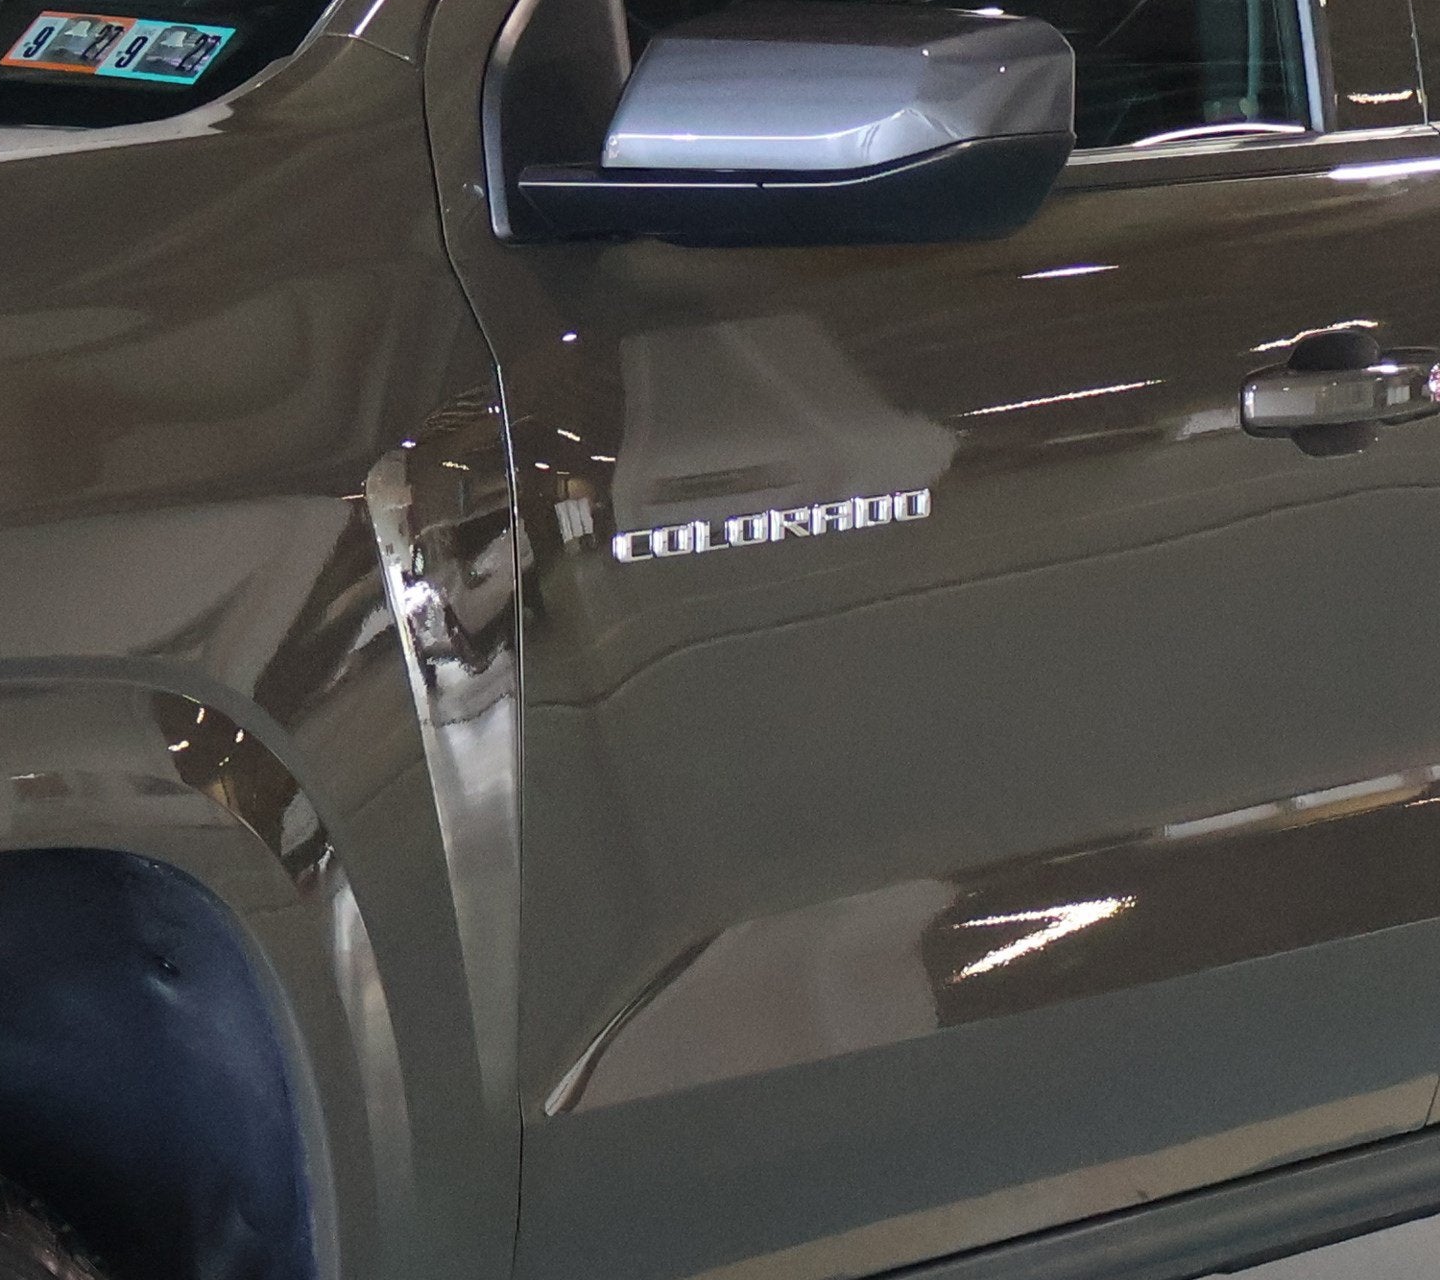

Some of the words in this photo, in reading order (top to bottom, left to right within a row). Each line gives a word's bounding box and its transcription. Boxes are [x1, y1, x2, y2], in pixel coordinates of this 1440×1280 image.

[23, 26, 55, 59] 9
[114, 35, 149, 69] 9
[612, 487, 933, 564] COLORADO
